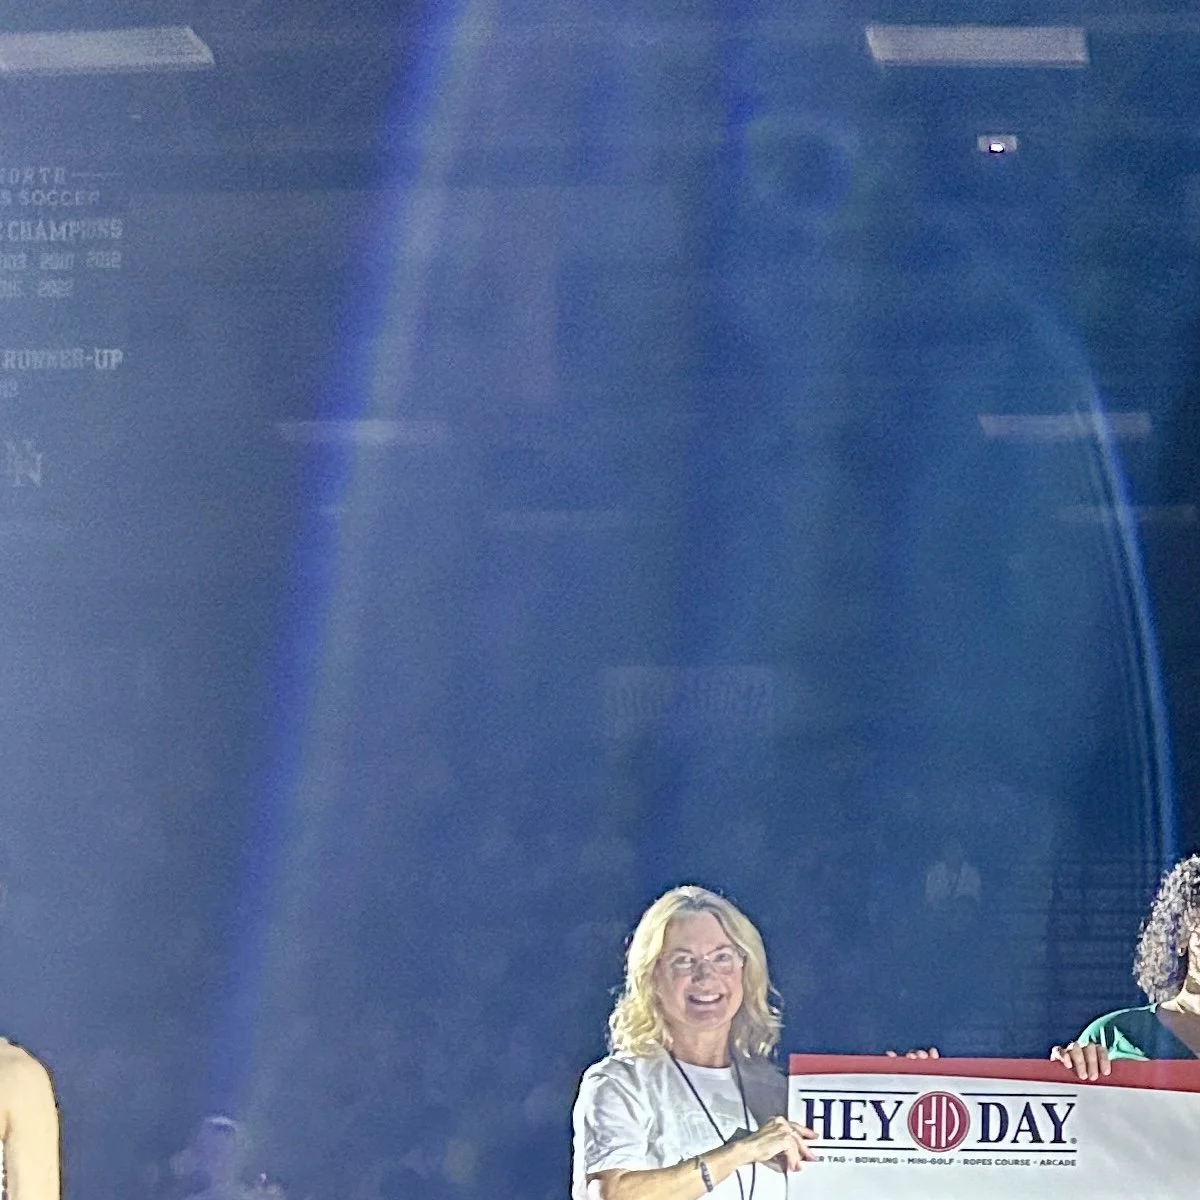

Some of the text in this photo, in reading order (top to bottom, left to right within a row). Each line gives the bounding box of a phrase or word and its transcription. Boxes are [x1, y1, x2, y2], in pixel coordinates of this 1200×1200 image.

[7, 219, 123, 241] CHAMPIONS
[2, 347, 124, 370] RUNNER-UP
[801, 1097, 903, 1141] HEY
[855, 1157, 899, 1165] BOWLING
[907, 1157, 955, 1166] MINI-GOLF
[963, 1158, 993, 1167] ROPES
[995, 1158, 1031, 1167] COURSE
[1039, 1159, 1077, 1167] ARCADE
